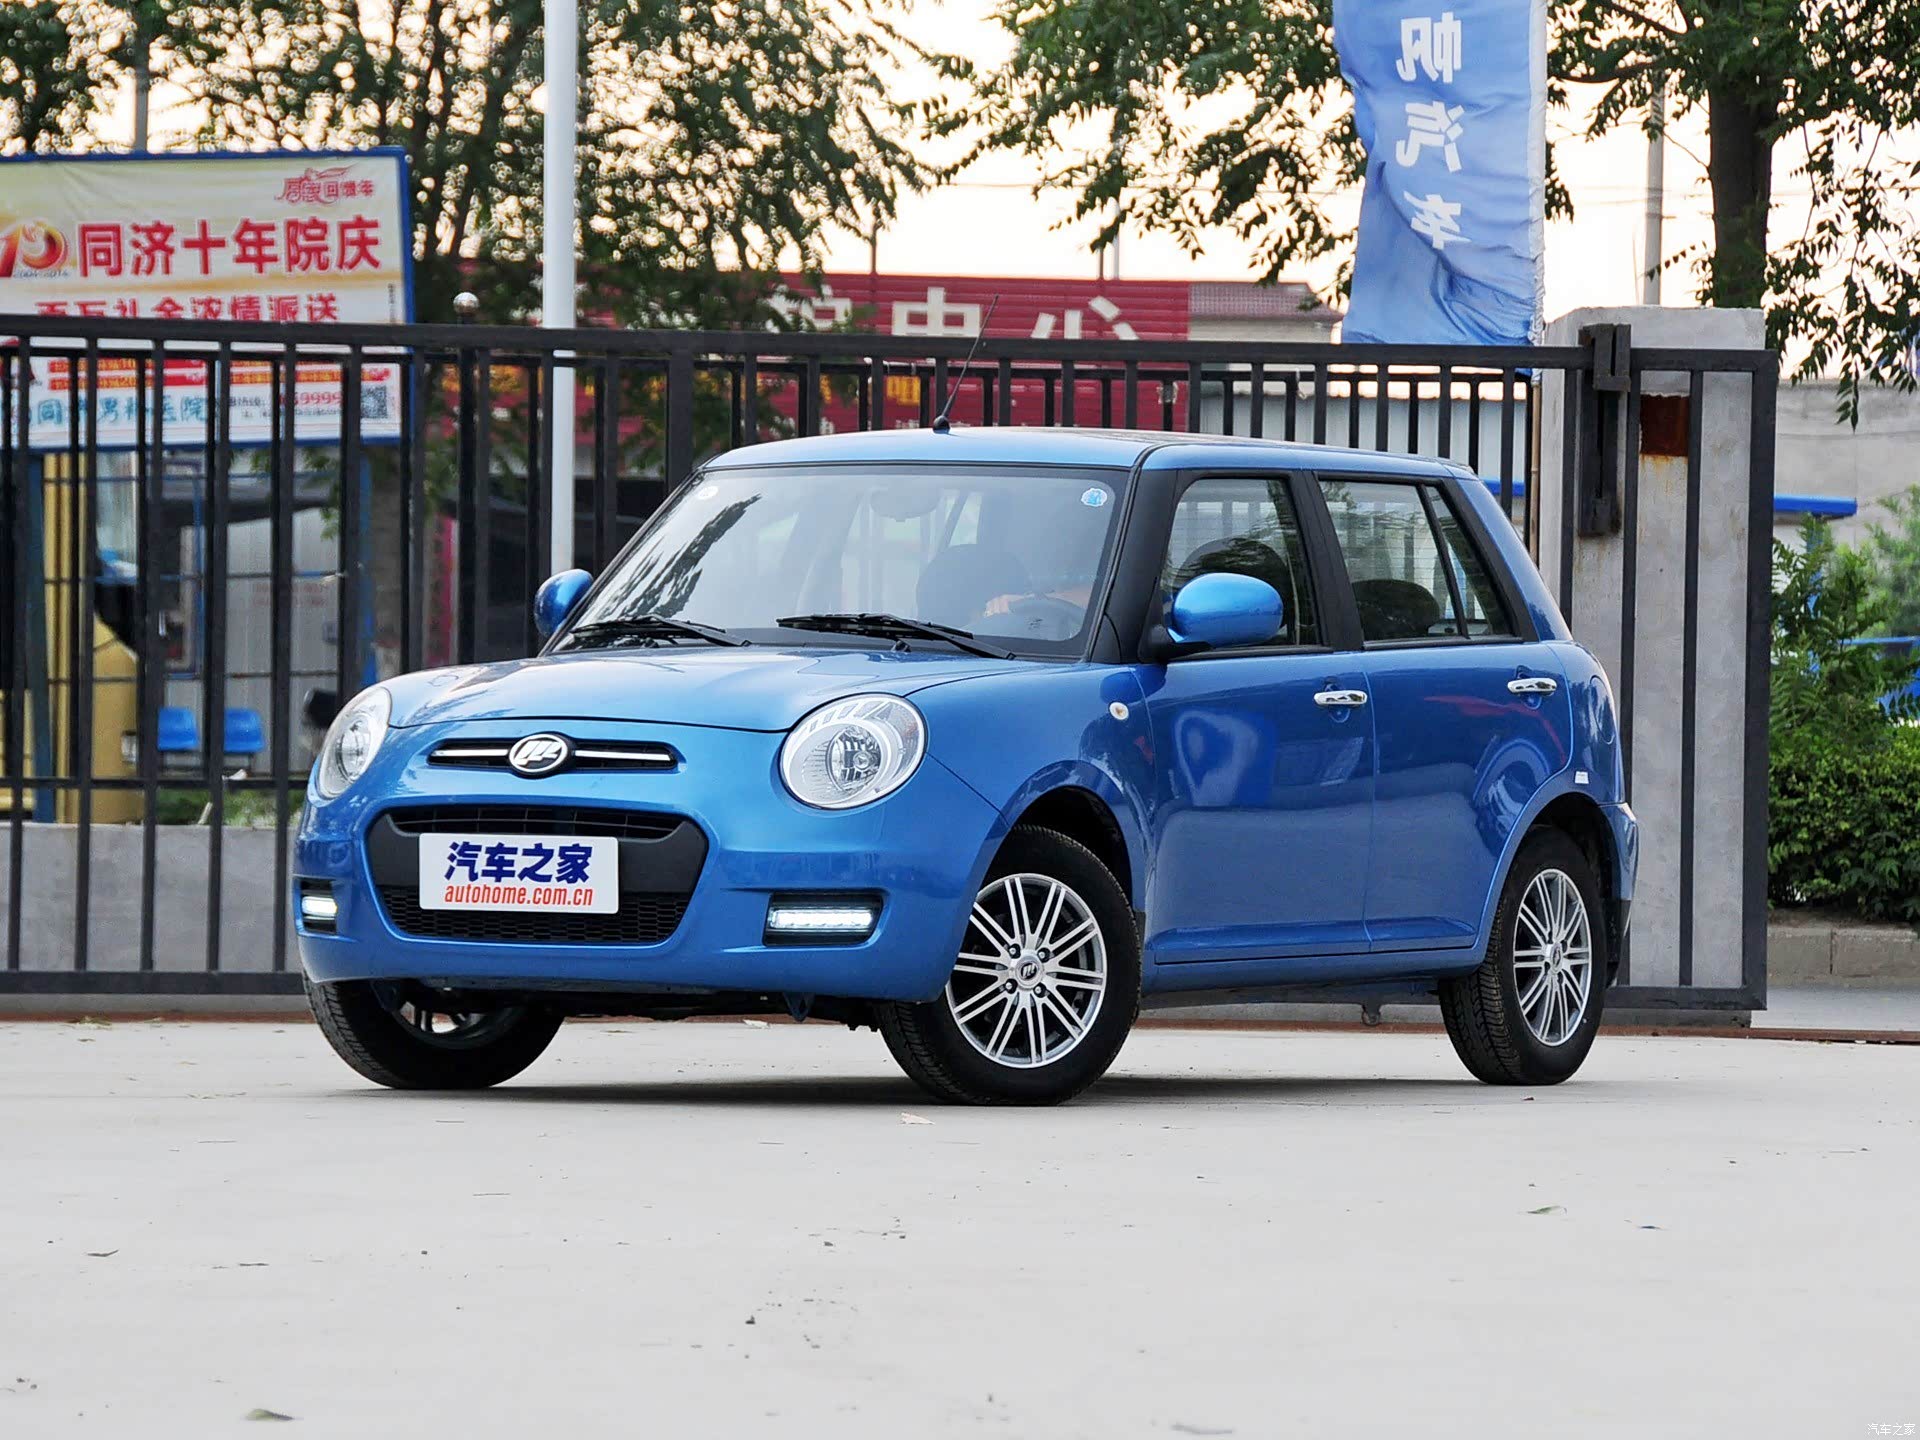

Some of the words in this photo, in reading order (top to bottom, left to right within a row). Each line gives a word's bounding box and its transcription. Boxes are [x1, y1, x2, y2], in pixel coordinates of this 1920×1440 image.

[79, 214, 382, 278] 同济十年院庆
[444, 841, 593, 884] 汽车之家
[444, 884, 594, 906] autohome.com.cn
